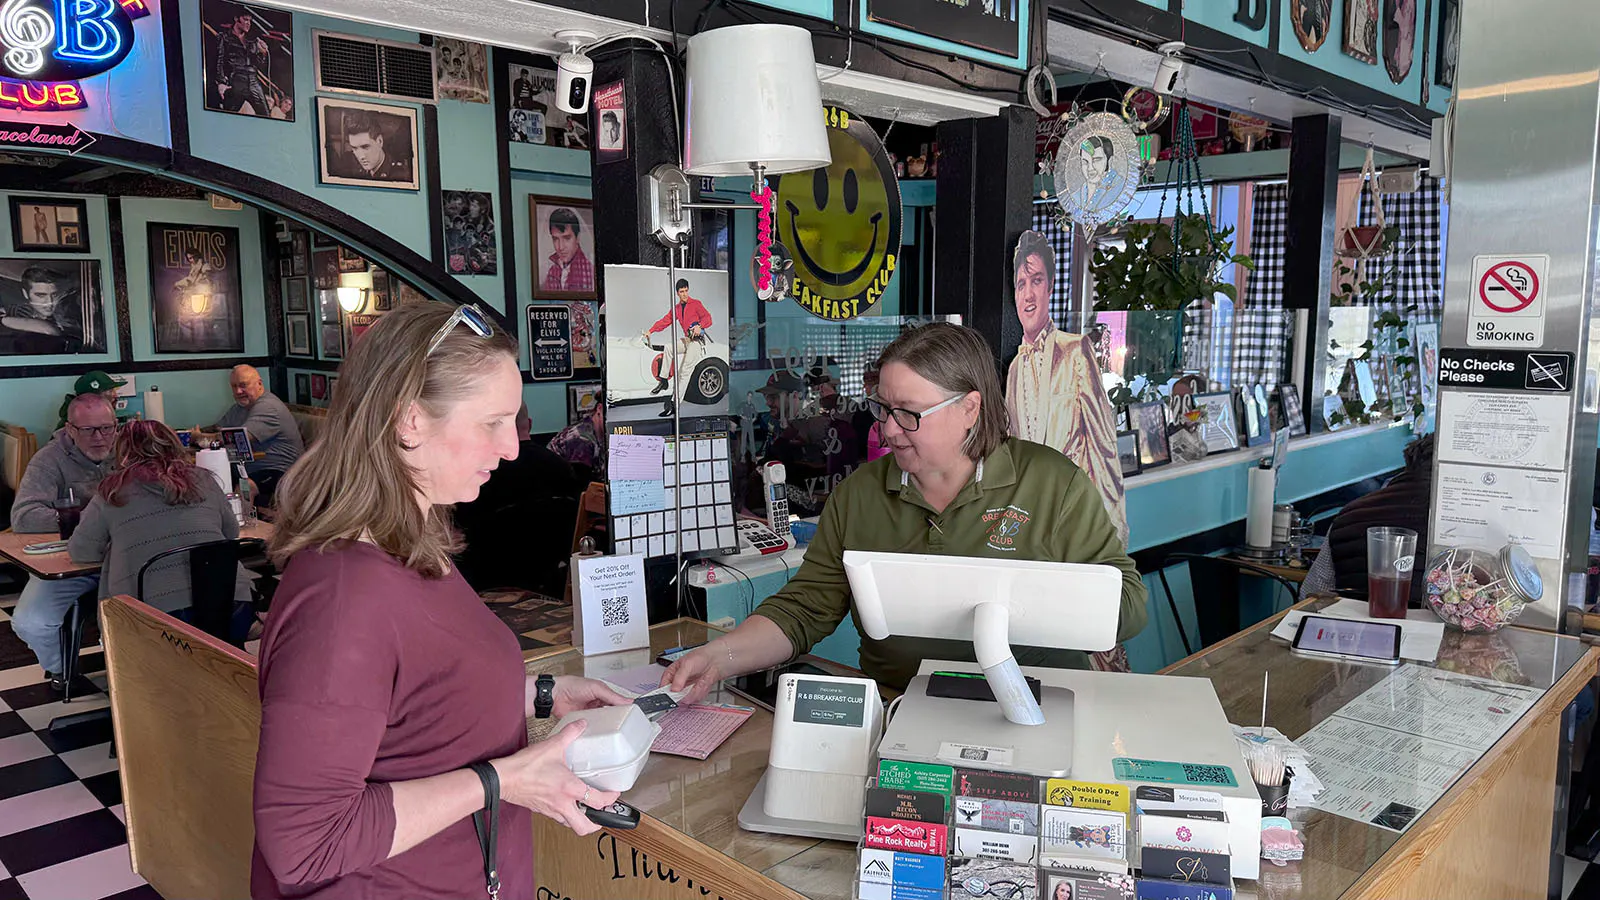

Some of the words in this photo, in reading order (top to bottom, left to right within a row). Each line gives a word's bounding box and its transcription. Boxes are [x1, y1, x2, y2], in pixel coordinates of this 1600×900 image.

[598, 94, 623, 109] HOTEL
[163, 229, 226, 271] ELVIS
[792, 277, 860, 319] EAKFAST
[866, 254, 896, 304] CLUB
[530, 311, 568, 320] RESERVED
[1476, 322, 1495, 331] NO
[540, 328, 560, 337] ELVIS
[1476, 332, 1534, 342] SMOKING
[1440, 358, 1460, 370] No
[1463, 359, 1515, 372] Checks
[1440, 370, 1484, 382] Please
[989, 534, 1014, 545] CLUB
[814, 694, 847, 702] BREAKFAST
[880, 770, 911, 779] ETCHED
[1001, 790, 1030, 798] ABOVE
[1072, 786, 1096, 794] Double
[1105, 788, 1119, 796] Dog
[1079, 796, 1112, 806] Training
[891, 812, 921, 820] PROJECTS
[868, 834, 883, 844] Pine
[885, 836, 903, 846] Rock
[904, 839, 927, 849] Realty
[864, 870, 890, 878] FAITHFUL
